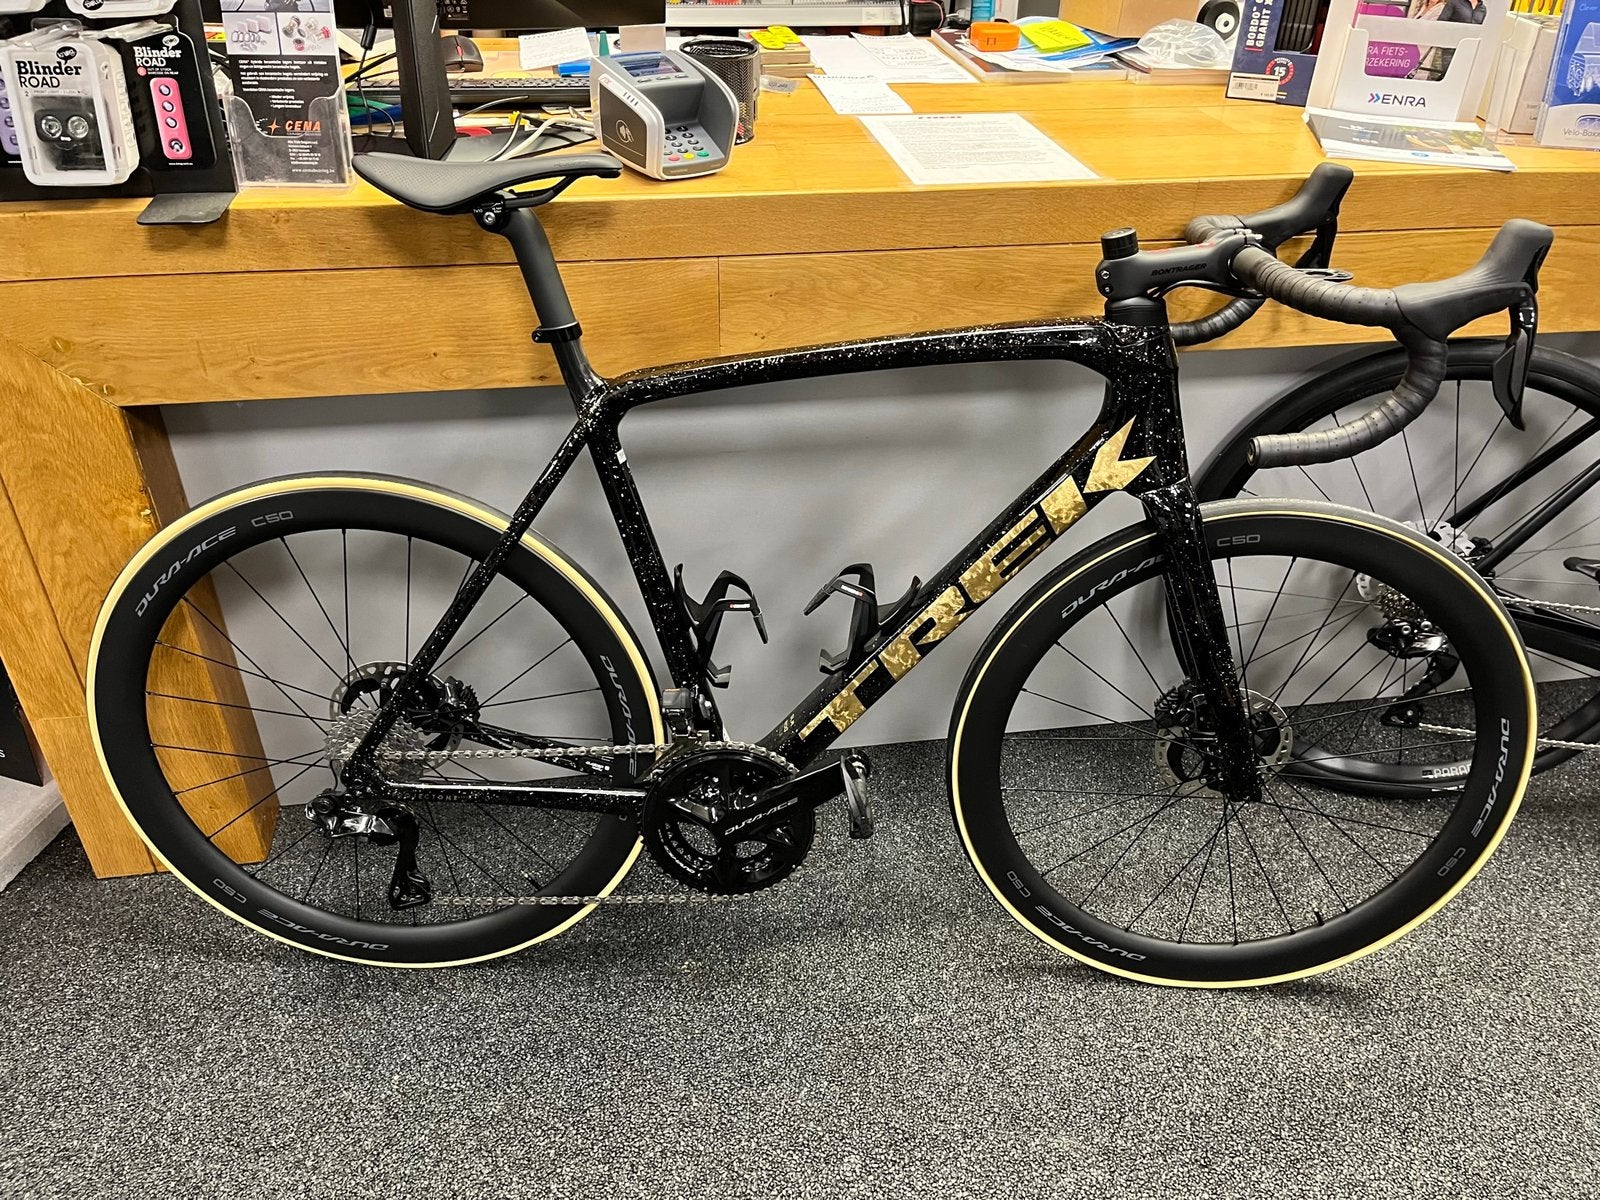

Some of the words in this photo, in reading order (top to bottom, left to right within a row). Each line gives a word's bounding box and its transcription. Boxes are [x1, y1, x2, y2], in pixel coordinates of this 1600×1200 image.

[1255, 8, 1271, 47] GRANIT
[132, 46, 182, 58] Blinder
[1368, 46, 1379, 55] RA
[1381, 46, 1409, 56] FIETS-
[15, 60, 82, 76] Blinder
[135, 57, 167, 67] ROAD
[1274, 66, 1287, 77] 15
[19, 75, 60, 89] ROAD
[1381, 93, 1427, 108] ENRA
[285, 120, 321, 132] CEMA
[1151, 263, 1207, 276] BONTRAGER
[251, 510, 294, 528] C50
[1216, 534, 1261, 547] C50
[135, 525, 236, 618] DURA-ACE
[798, 415, 1157, 740] TREK
[1061, 553, 1166, 619] DURA-AC
[1434, 763, 1472, 779] PARA
[1471, 718, 1510, 838] DURA-ACE
[724, 797, 799, 836] DURA-ACE
[1436, 847, 1466, 877] C50
[212, 878, 247, 904] C50
[1006, 870, 1031, 898] C50
[257, 908, 390, 951] DURA-ACE
[1034, 905, 1147, 961] DURA-ACE
